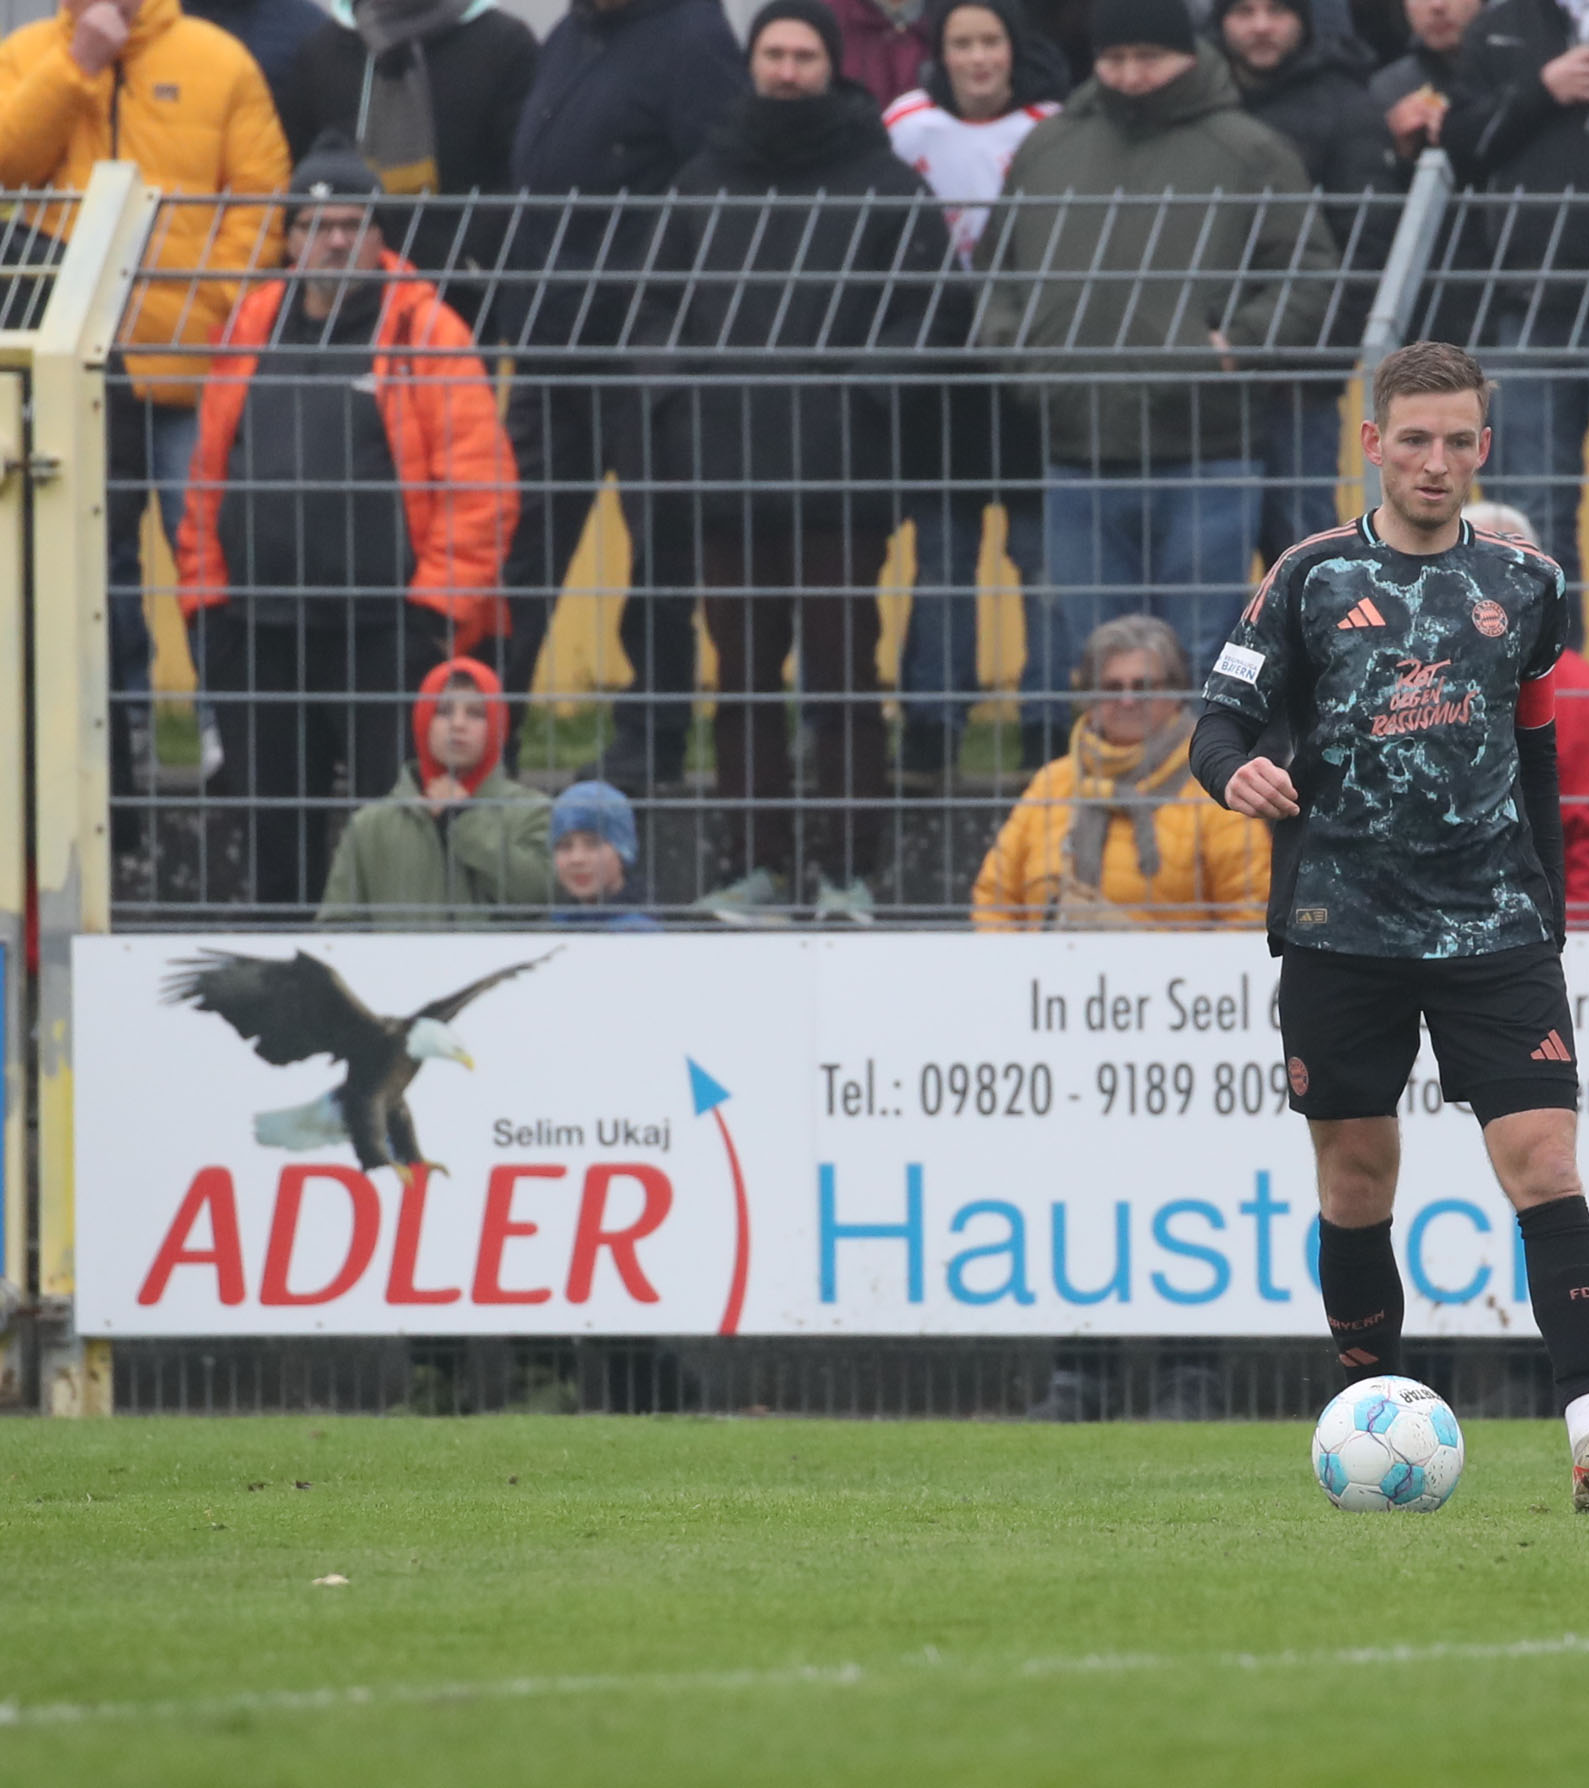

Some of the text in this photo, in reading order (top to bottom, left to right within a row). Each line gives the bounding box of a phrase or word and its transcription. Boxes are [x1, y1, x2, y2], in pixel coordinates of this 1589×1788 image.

[1396, 658, 1452, 692] ROT
[1370, 689, 1480, 736] RASSISMUS
[1030, 978, 1067, 1032] In
[1084, 973, 1151, 1032] der
[1166, 973, 1250, 1032] Seel
[820, 1059, 902, 1117] Tel.:
[920, 1062, 1053, 1117] 09820
[1096, 1062, 1195, 1117] 9189
[1213, 1062, 1289, 1117] 809
[491, 1119, 671, 1156] Selim Ukaj
[137, 1162, 673, 1306] ADLER
